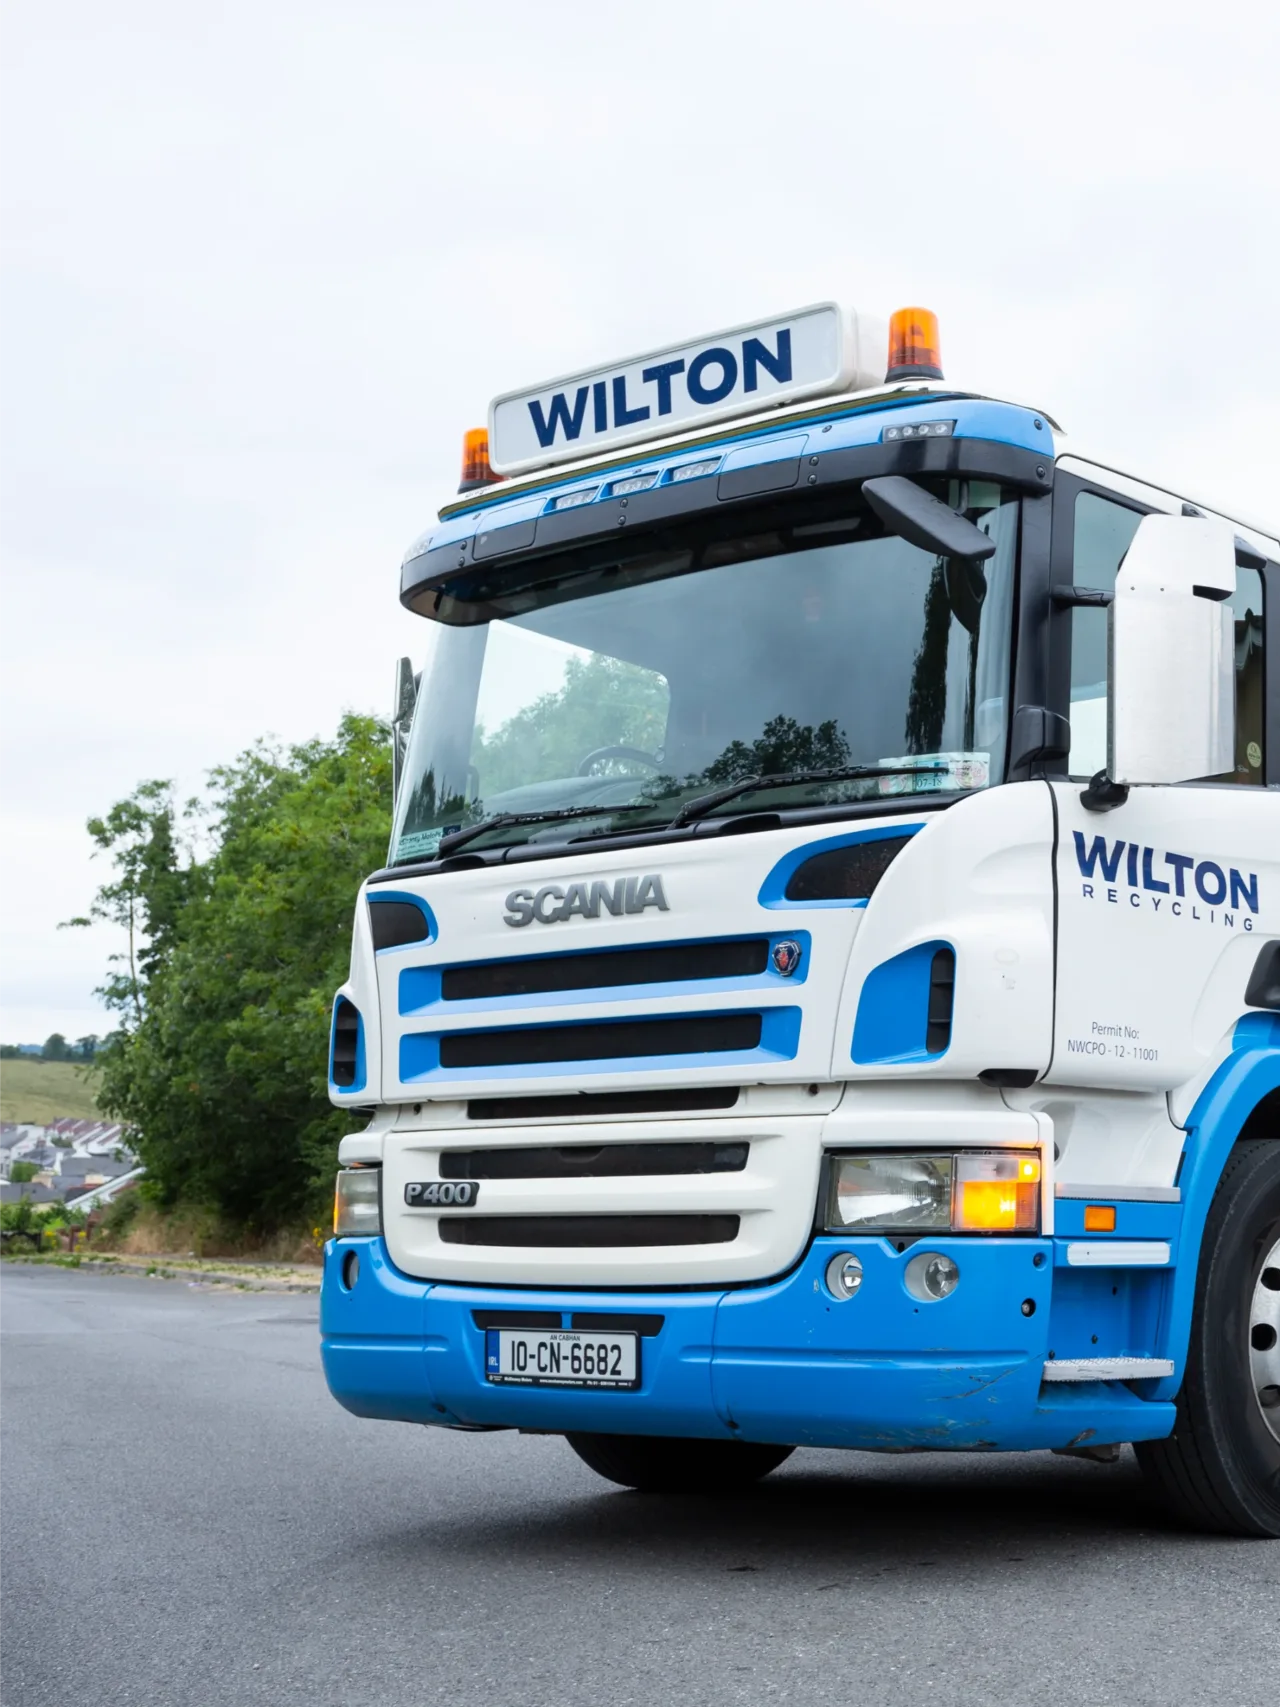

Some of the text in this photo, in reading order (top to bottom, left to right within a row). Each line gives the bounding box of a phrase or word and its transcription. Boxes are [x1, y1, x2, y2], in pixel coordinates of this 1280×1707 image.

[527, 328, 793, 449] WILTON
[1072, 830, 1259, 914] WILTON
[503, 874, 670, 928] SCANIA
[1082, 884, 1253, 931] RECYCLING
[1067, 1039, 1106, 1056] NWCPO
[1114, 1045, 1125, 1058] 12
[1133, 1047, 1158, 1061] 11001
[1091, 1021, 1140, 1040] Permit No:
[488, 1356, 498, 1366] IRL
[511, 1340, 622, 1376] 10-CN-6682
